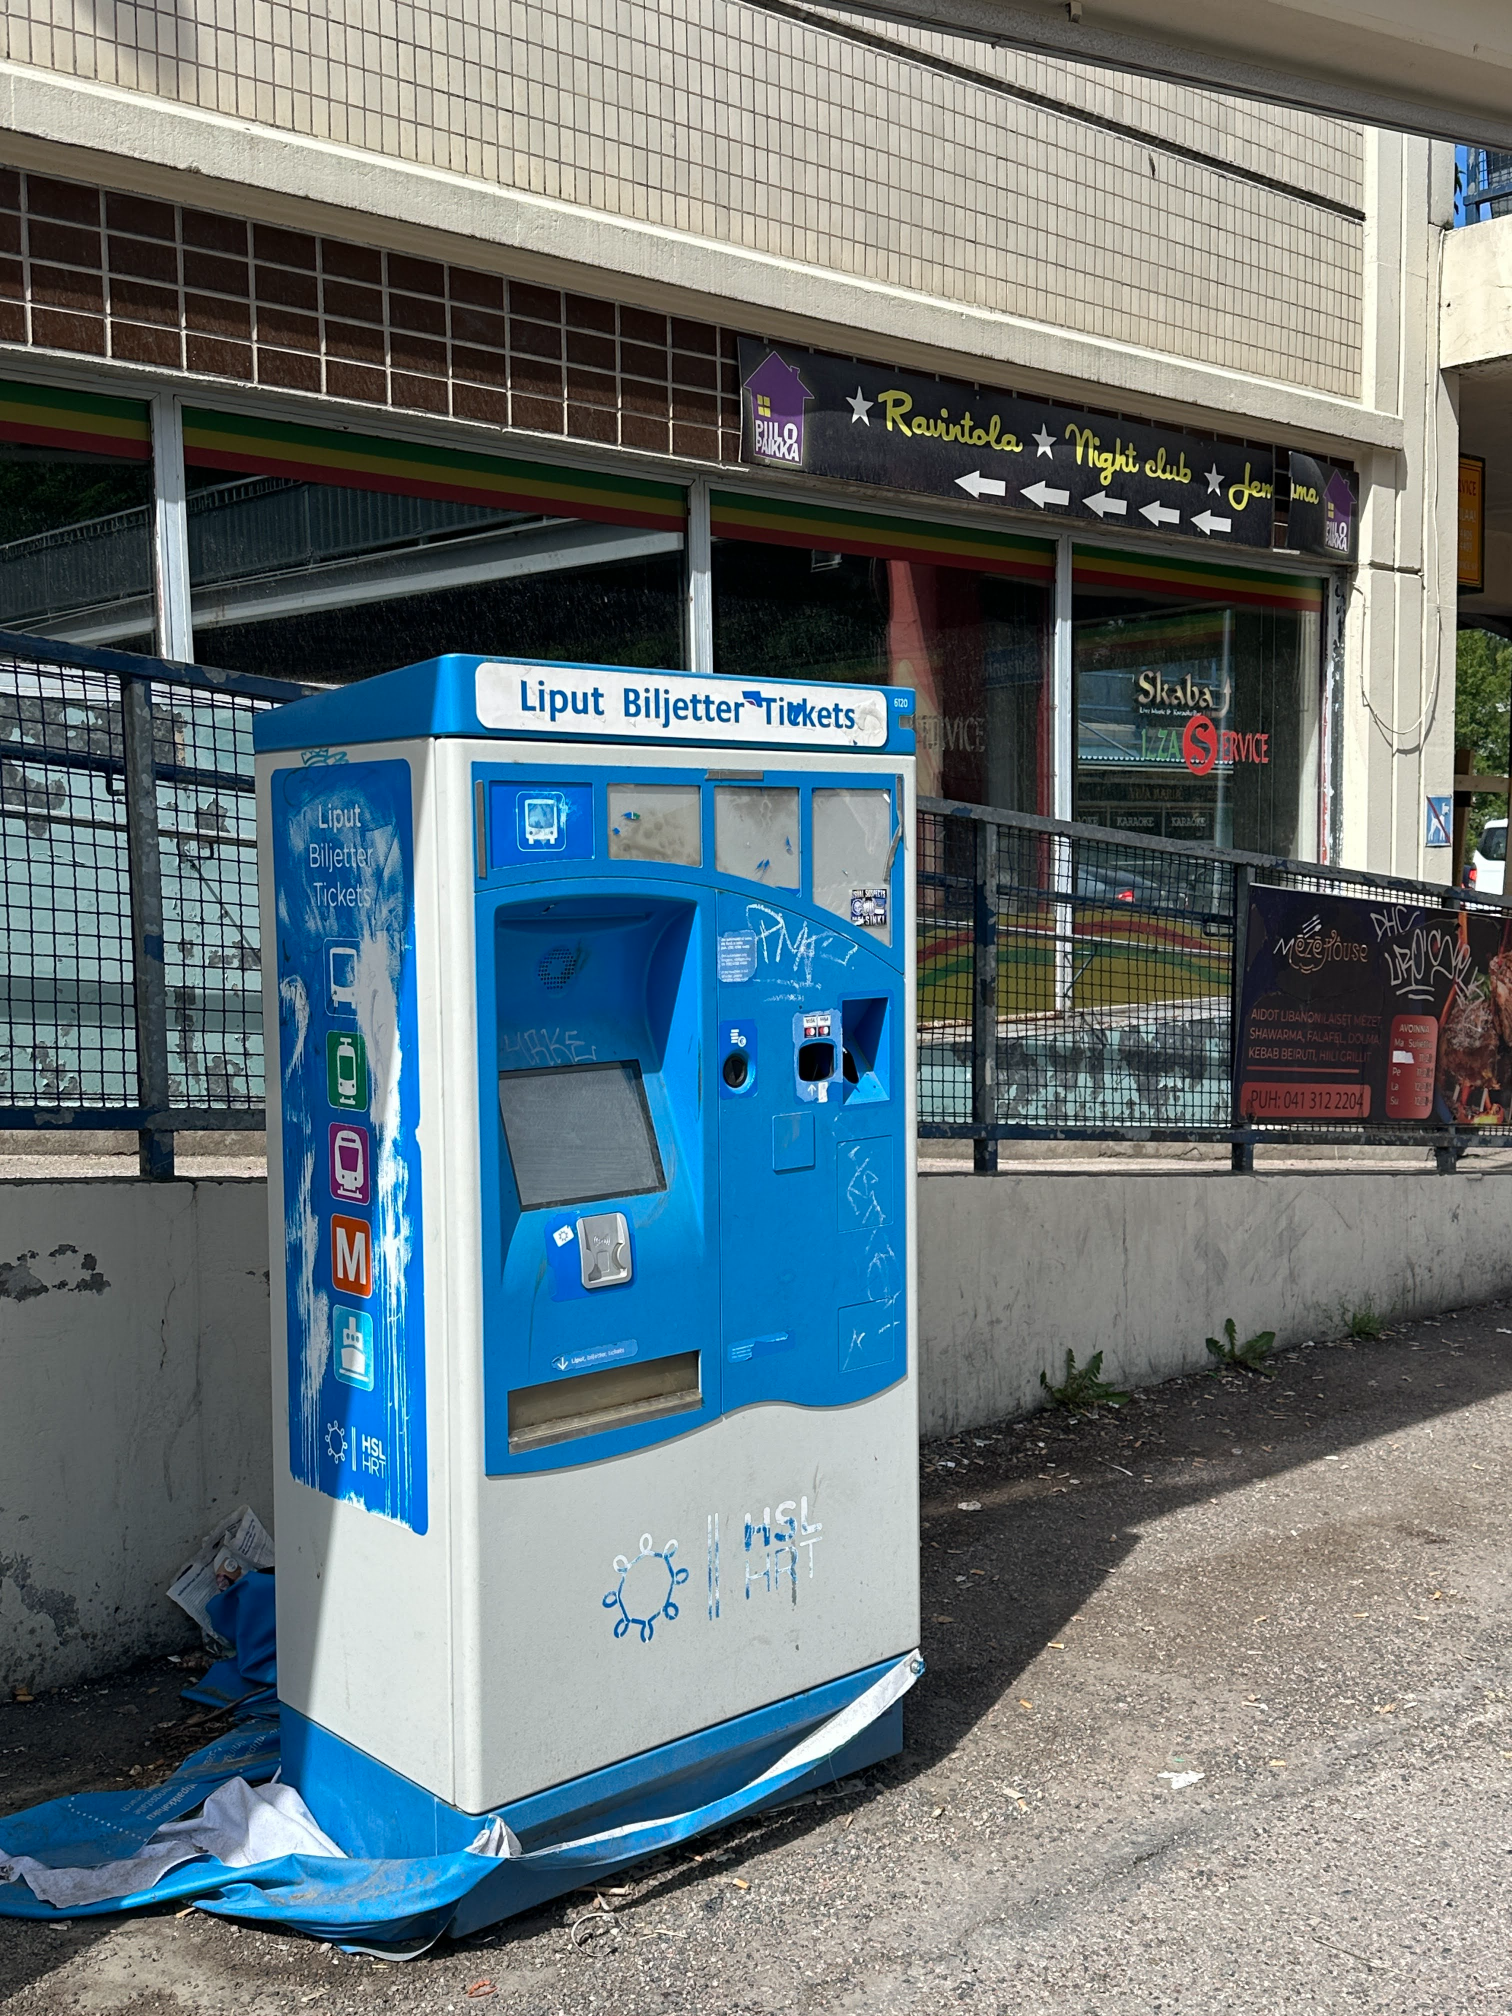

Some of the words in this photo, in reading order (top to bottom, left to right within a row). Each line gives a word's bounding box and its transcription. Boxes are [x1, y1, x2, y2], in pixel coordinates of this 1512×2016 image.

[755, 420, 798, 444] PIILO
[877, 389, 1023, 453] Ravintola
[1065, 423, 1139, 486] Night
[1144, 447, 1192, 484] club
[755, 437, 800, 462] PAIKKA
[1138, 670, 1214, 708] Skaba
[520, 679, 605, 722] Liput
[623, 687, 746, 728] Biljetter
[894, 697, 908, 709] 6120
[318, 803, 361, 832] Liput
[309, 843, 374, 872] Biljetter
[313, 882, 373, 907] Tickets
[1250, 1008, 1279, 1021] AIDOT
[1399, 1024, 1430, 1033] AVOINNA
[1248, 1046, 1279, 1059] KEBAB
[1392, 1067, 1402, 1076] Pe
[1391, 1082, 1399, 1091] La
[1251, 1090, 1280, 1109] PUH:
[1283, 1090, 1305, 1109] 041
[1309, 1092, 1331, 1109] 312
[1334, 1092, 1364, 1110] 2204
[335, 1226, 367, 1285] M
[362, 1433, 386, 1461] HSL
[362, 1457, 386, 1478] HRT
[744, 1495, 823, 1552] HSL
[745, 1536, 823, 1600] HRT
